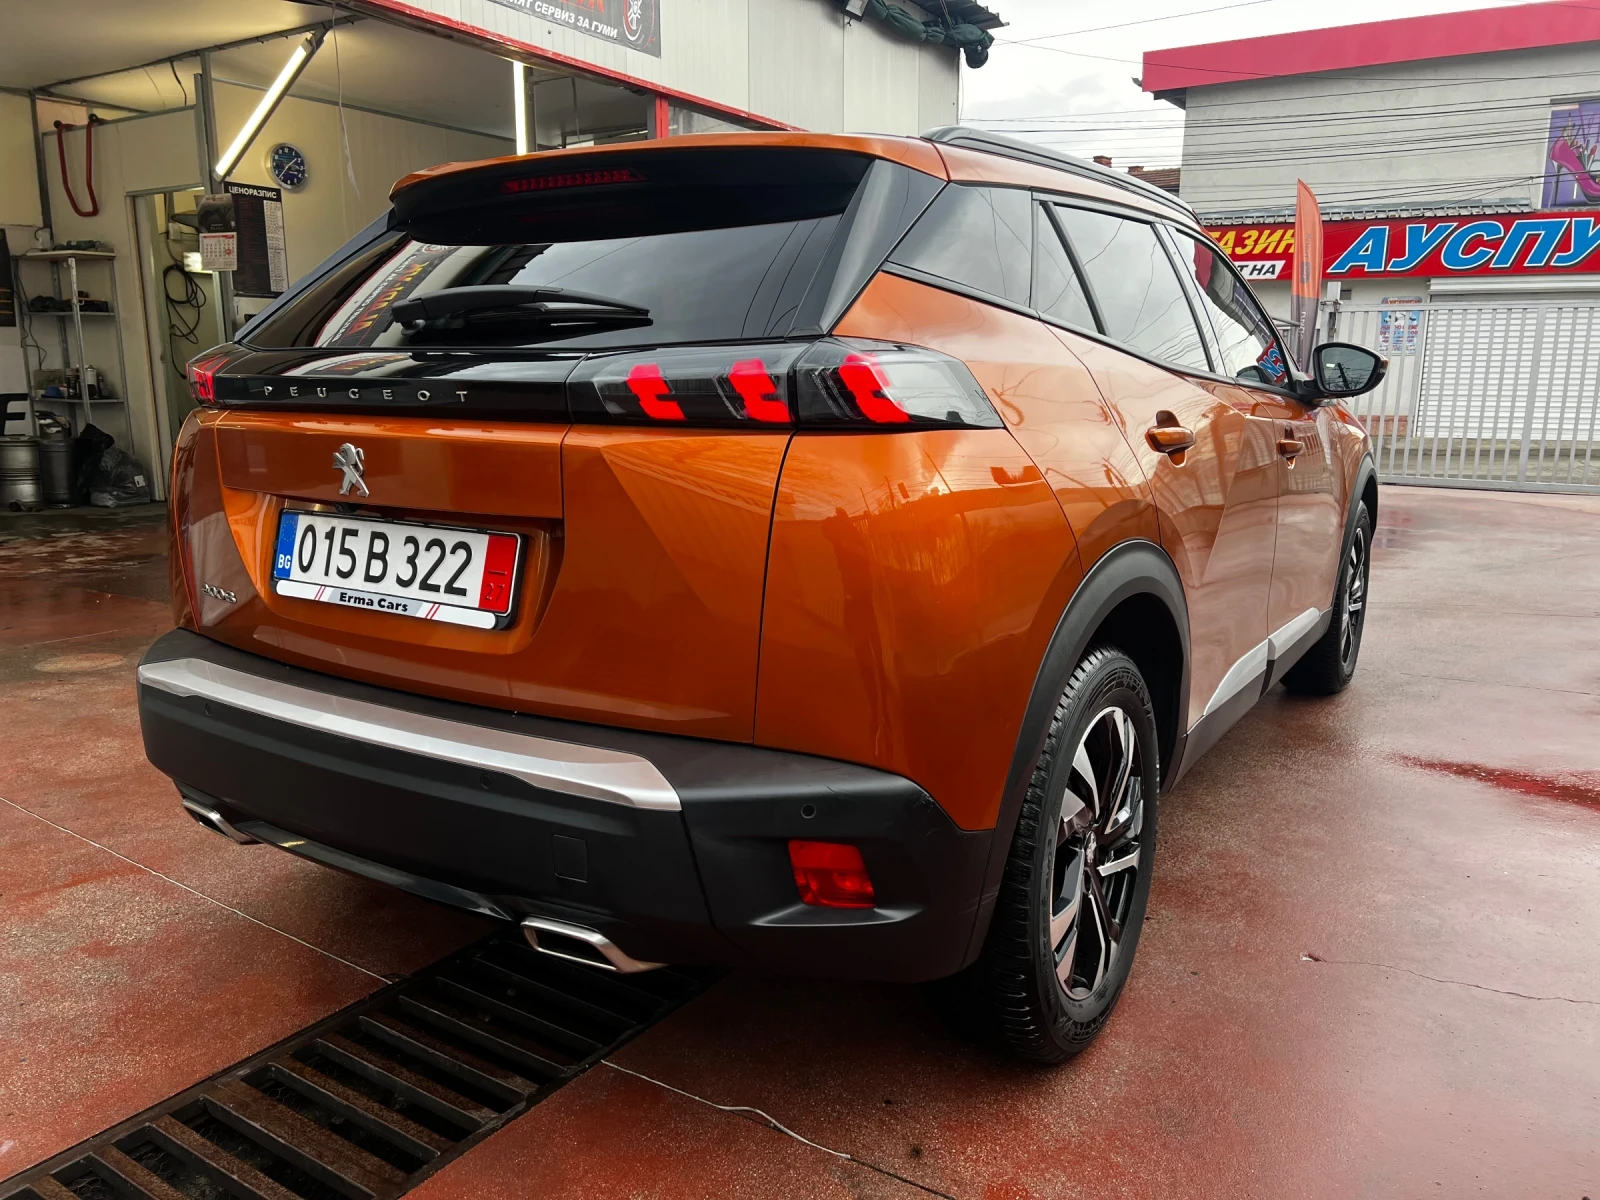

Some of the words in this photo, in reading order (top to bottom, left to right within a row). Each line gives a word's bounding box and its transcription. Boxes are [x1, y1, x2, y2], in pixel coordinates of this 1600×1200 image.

[534, 1, 575, 23] СЕРВИЗ
[577, 16, 590, 30] ЗА
[591, 21, 618, 38] ГУМИ
[228, 186, 277, 199] ЦЕНОРАЗПИС
[1249, 264, 1276, 276] НА
[264, 386, 467, 402] PEUGEOT
[278, 553, 291, 570] BG
[485, 583, 505, 602] 27
[339, 592, 374, 608] Erma
[377, 598, 409, 612] Cars
